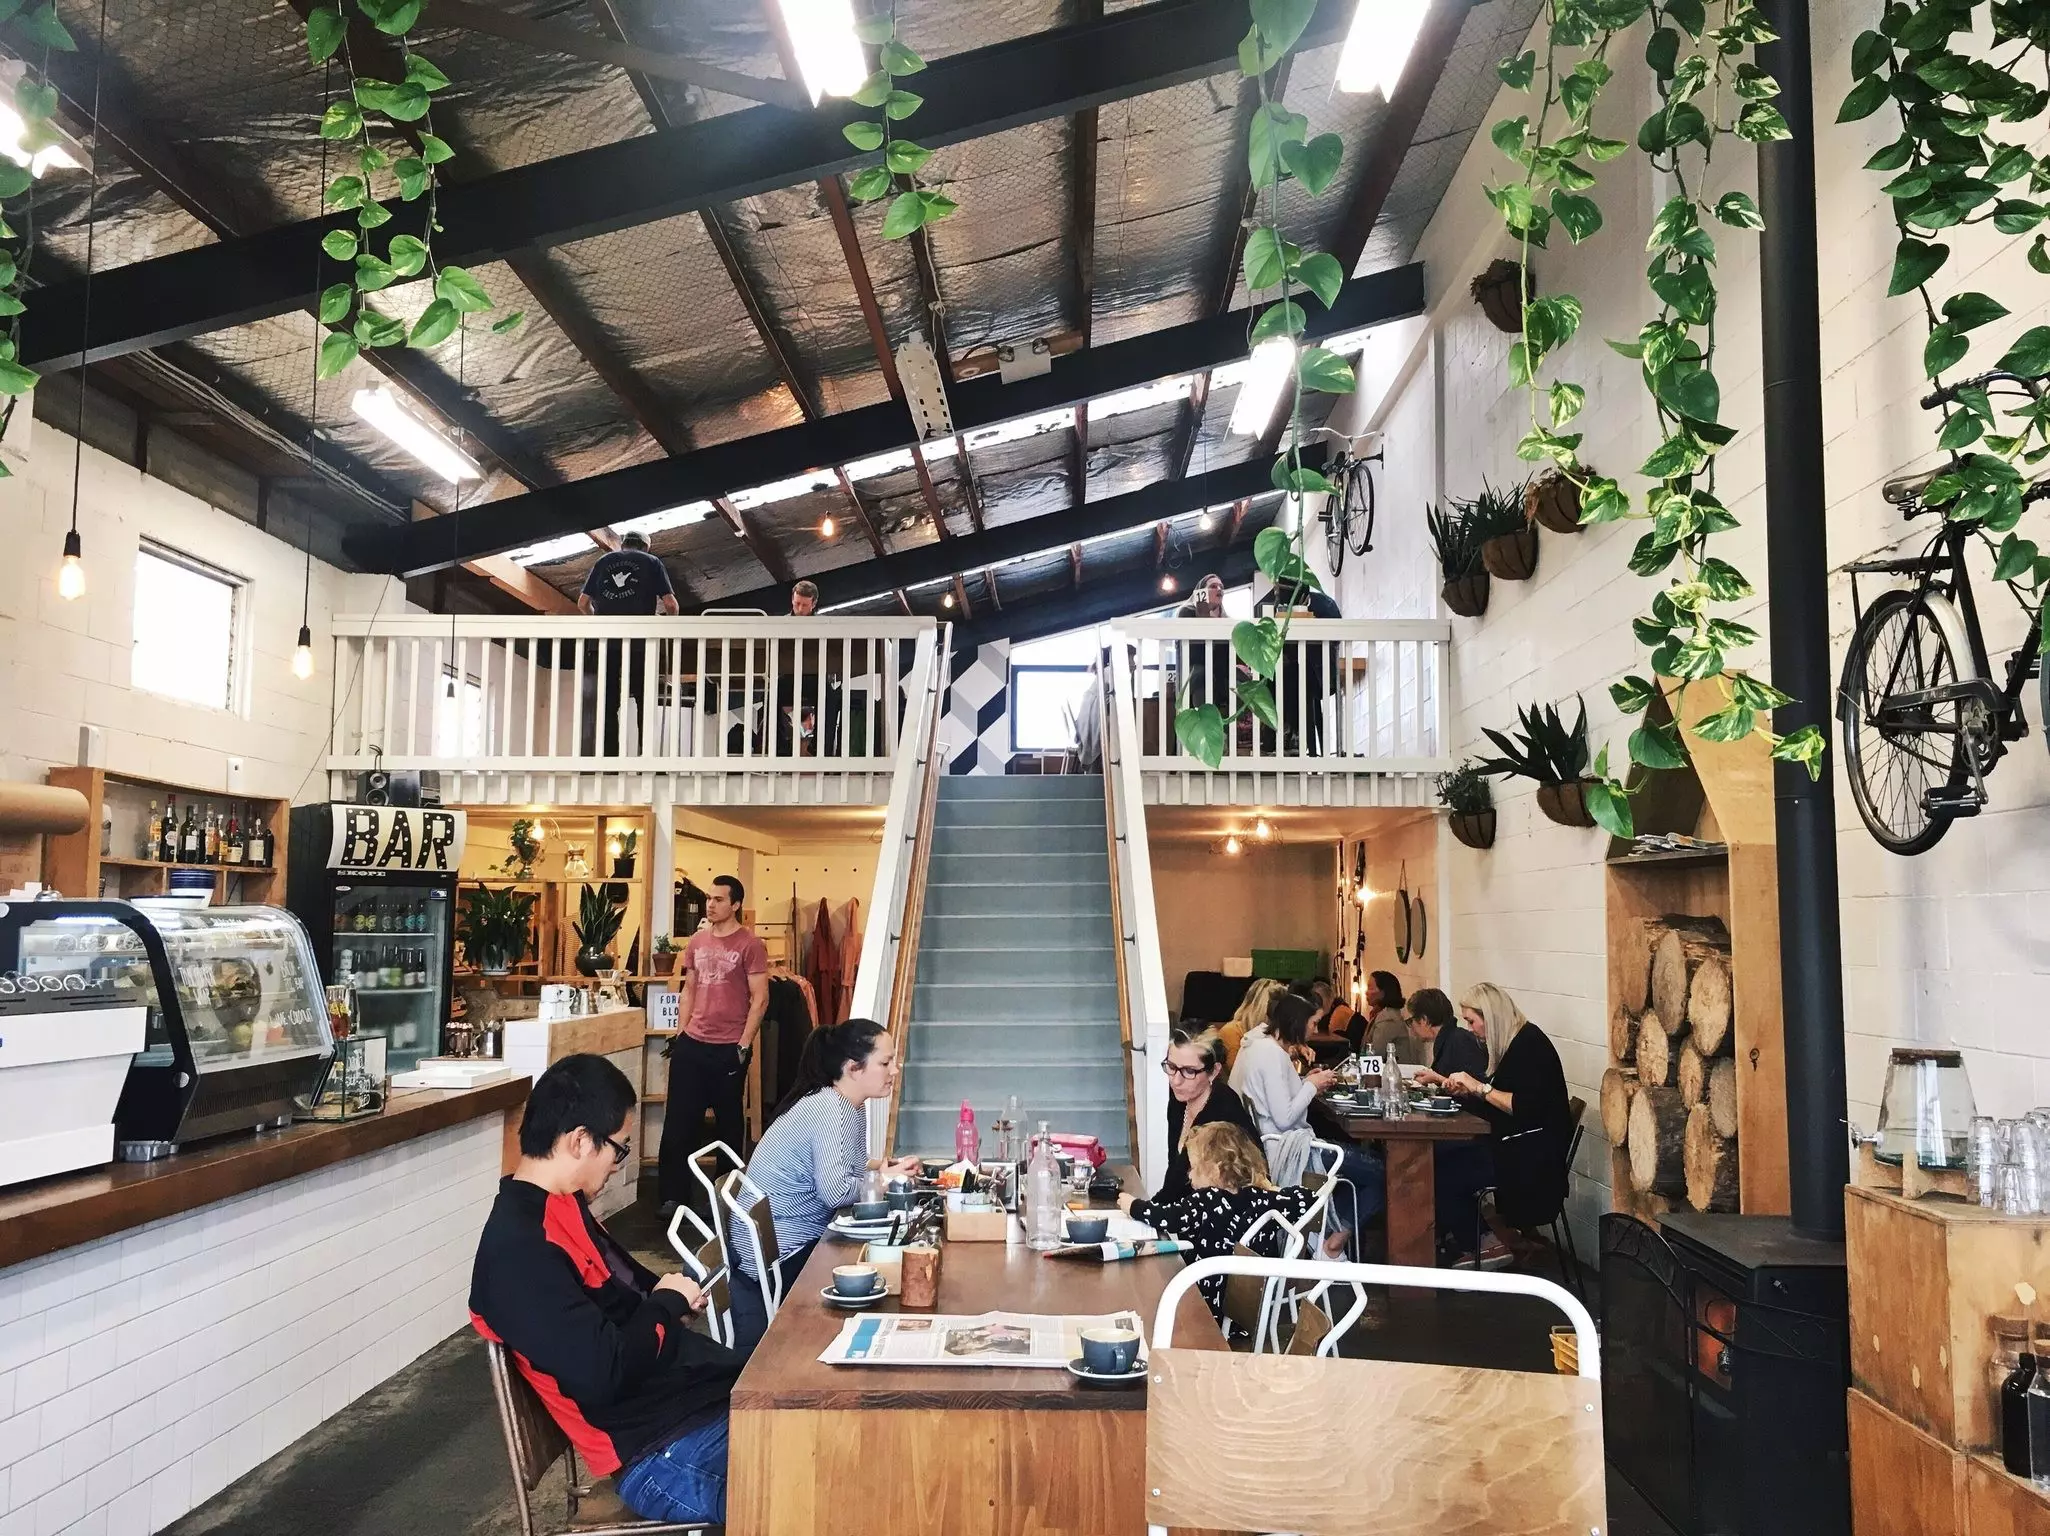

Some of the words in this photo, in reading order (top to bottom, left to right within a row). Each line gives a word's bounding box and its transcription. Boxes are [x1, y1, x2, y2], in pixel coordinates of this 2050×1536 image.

[1197, 591, 1207, 602] 12
[340, 808, 455, 869] BAR
[1363, 1059, 1380, 1073] 78
